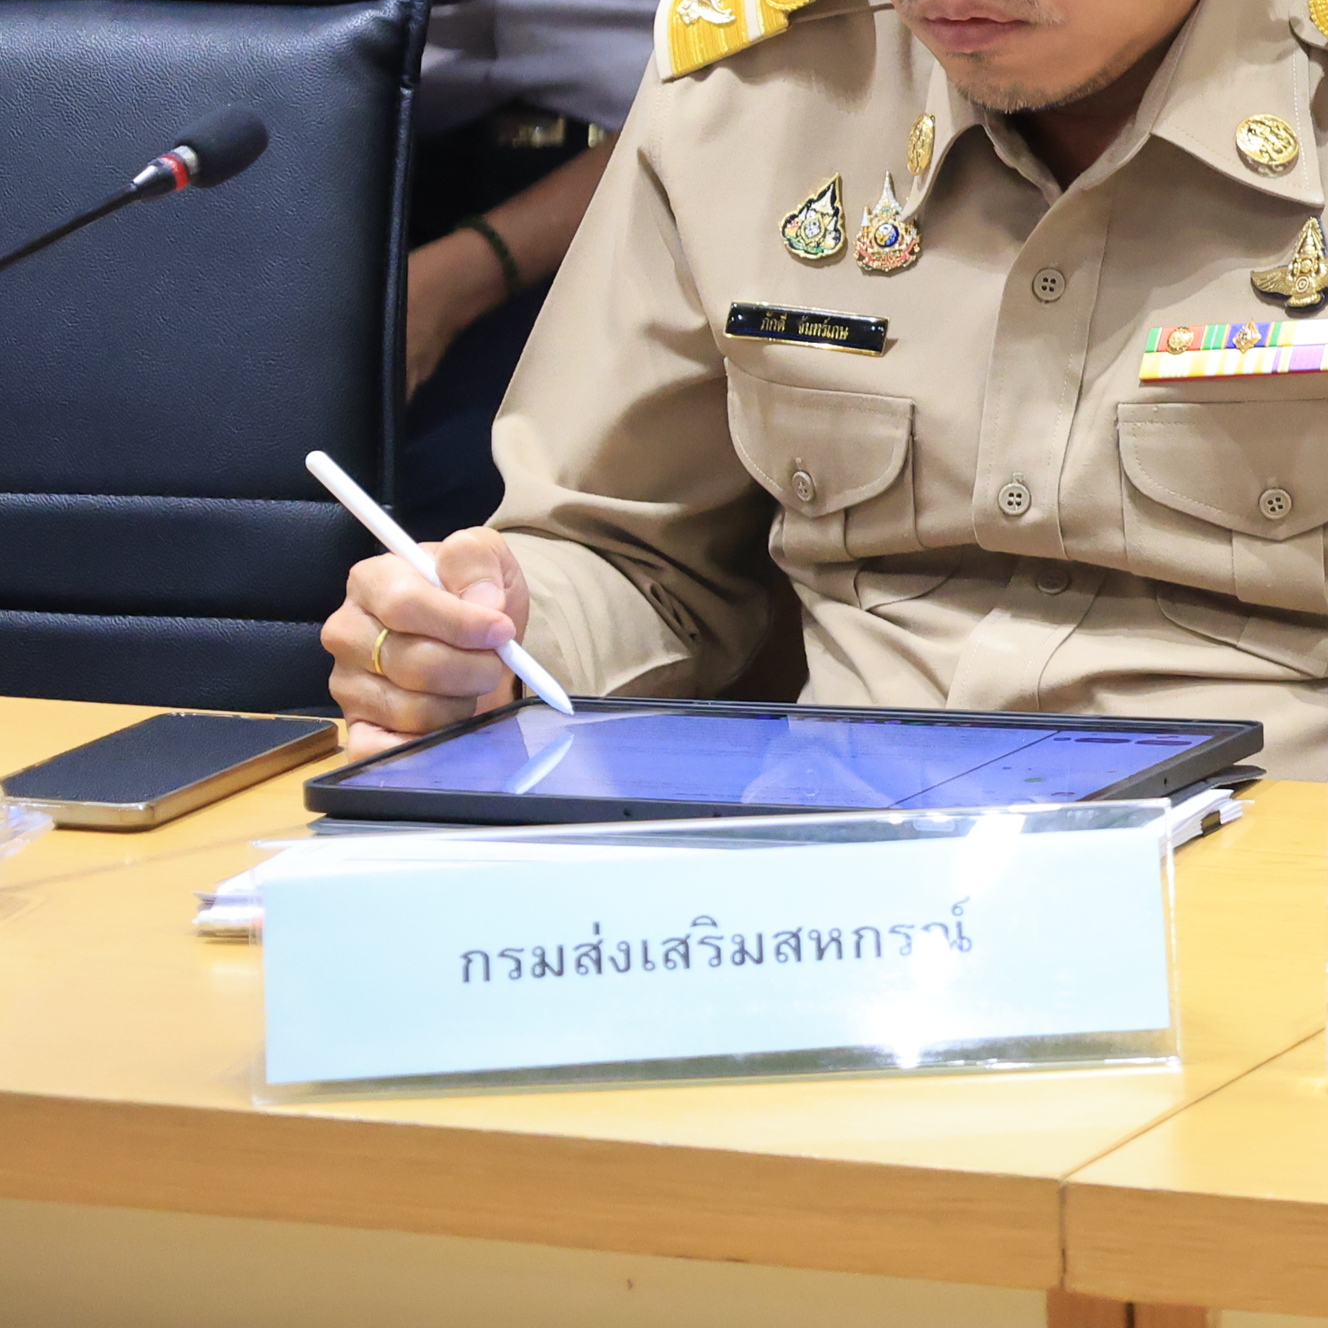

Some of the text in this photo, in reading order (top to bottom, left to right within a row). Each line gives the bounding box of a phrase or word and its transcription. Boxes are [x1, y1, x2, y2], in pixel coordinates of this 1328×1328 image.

[760, 311, 849, 340] ภักดี จันทร์เกษ
